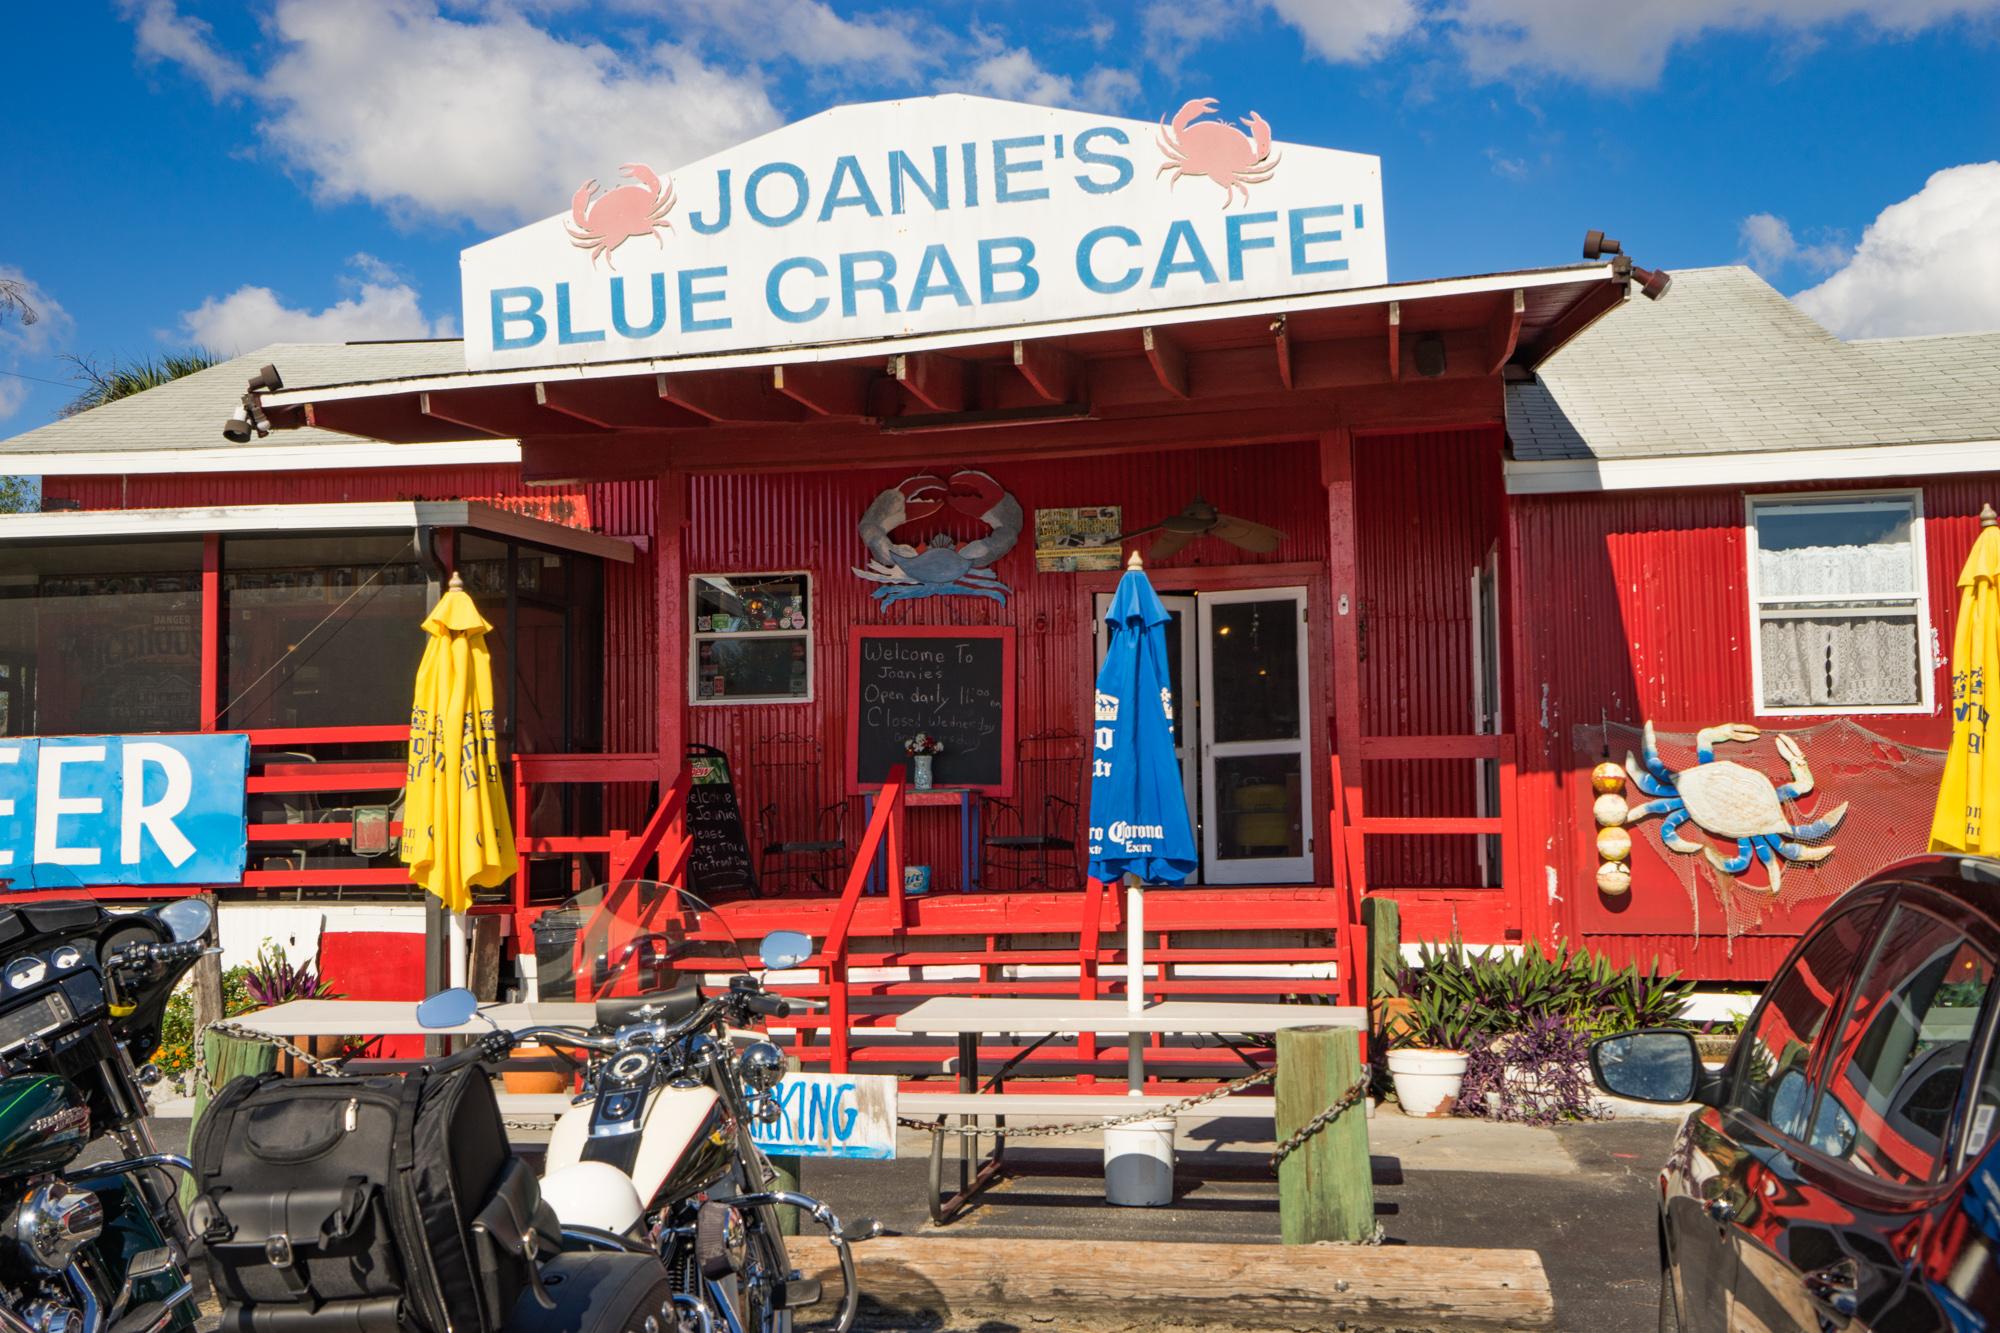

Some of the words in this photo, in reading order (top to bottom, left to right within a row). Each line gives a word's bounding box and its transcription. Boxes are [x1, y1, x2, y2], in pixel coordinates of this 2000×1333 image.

[690, 127, 1133, 234] JOANIE'S
[490, 266, 732, 351] BLUE
[766, 237, 1040, 323] CRAB
[1076, 203, 1365, 293] CAFE'
[153, 615, 191, 625] DANGER
[864, 642, 944, 663] Welcome
[955, 643, 974, 663] To
[878, 665, 943, 679] Joanie's
[864, 683, 904, 703] Open
[911, 683, 950, 714] daily
[867, 706, 921, 727] Closed
[687, 786, 732, 804] elcome
[1108, 821, 1164, 845] Corona
